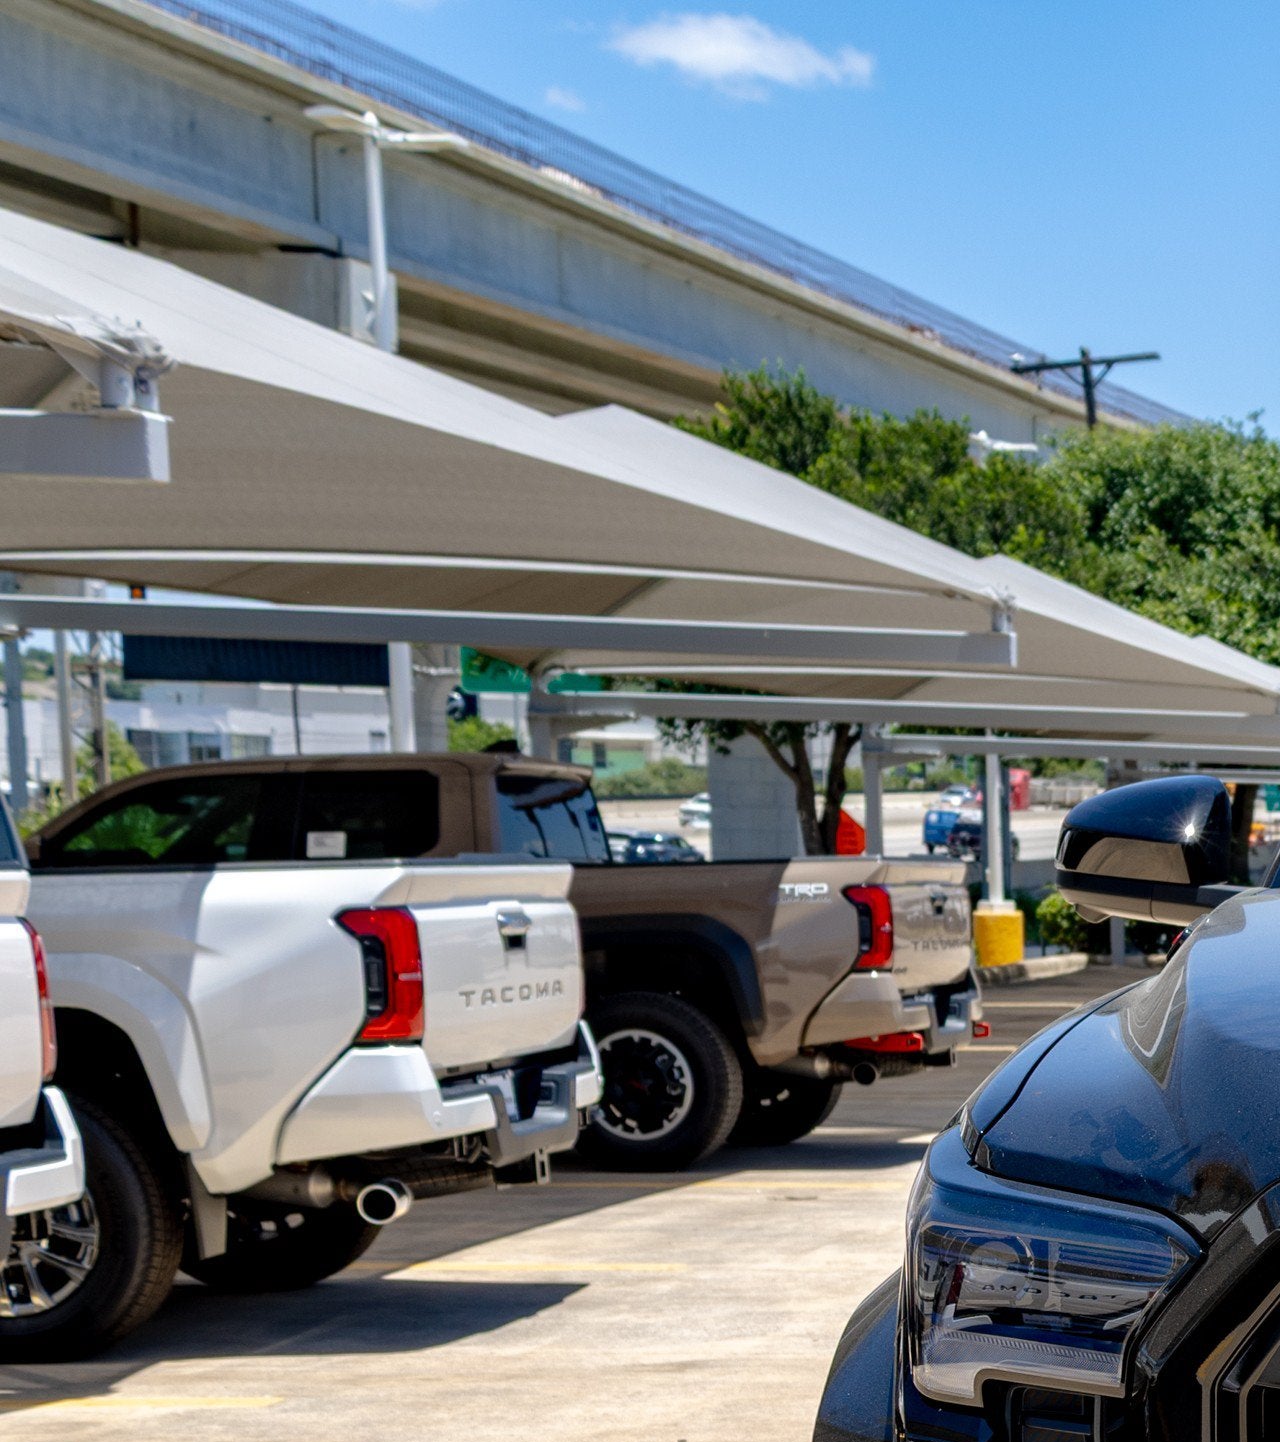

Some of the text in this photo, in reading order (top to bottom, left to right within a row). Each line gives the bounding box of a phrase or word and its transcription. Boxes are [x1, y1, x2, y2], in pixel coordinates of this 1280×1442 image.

[778, 882, 829, 898] TRD
[911, 939, 968, 951] TACOM
[458, 980, 564, 1008] TACOMA
